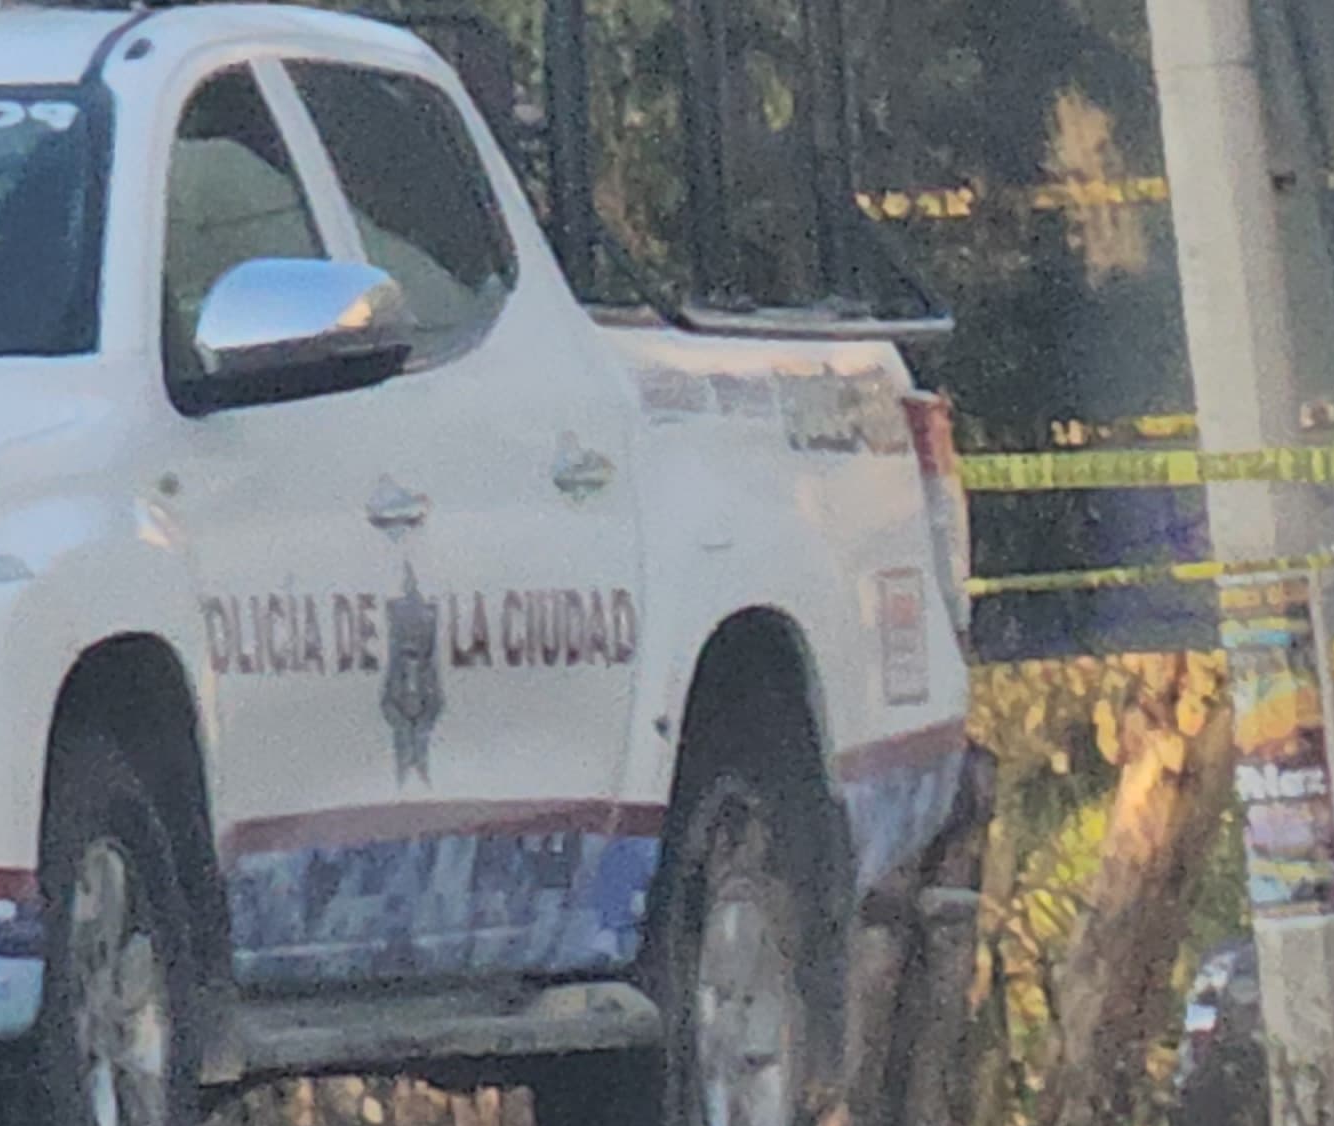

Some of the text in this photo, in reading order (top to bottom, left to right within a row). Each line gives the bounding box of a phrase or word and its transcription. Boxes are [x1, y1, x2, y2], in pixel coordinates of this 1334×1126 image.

[331, 592, 380, 673] DE
[448, 590, 492, 668] LA
[503, 587, 637, 669] CIUDAD
